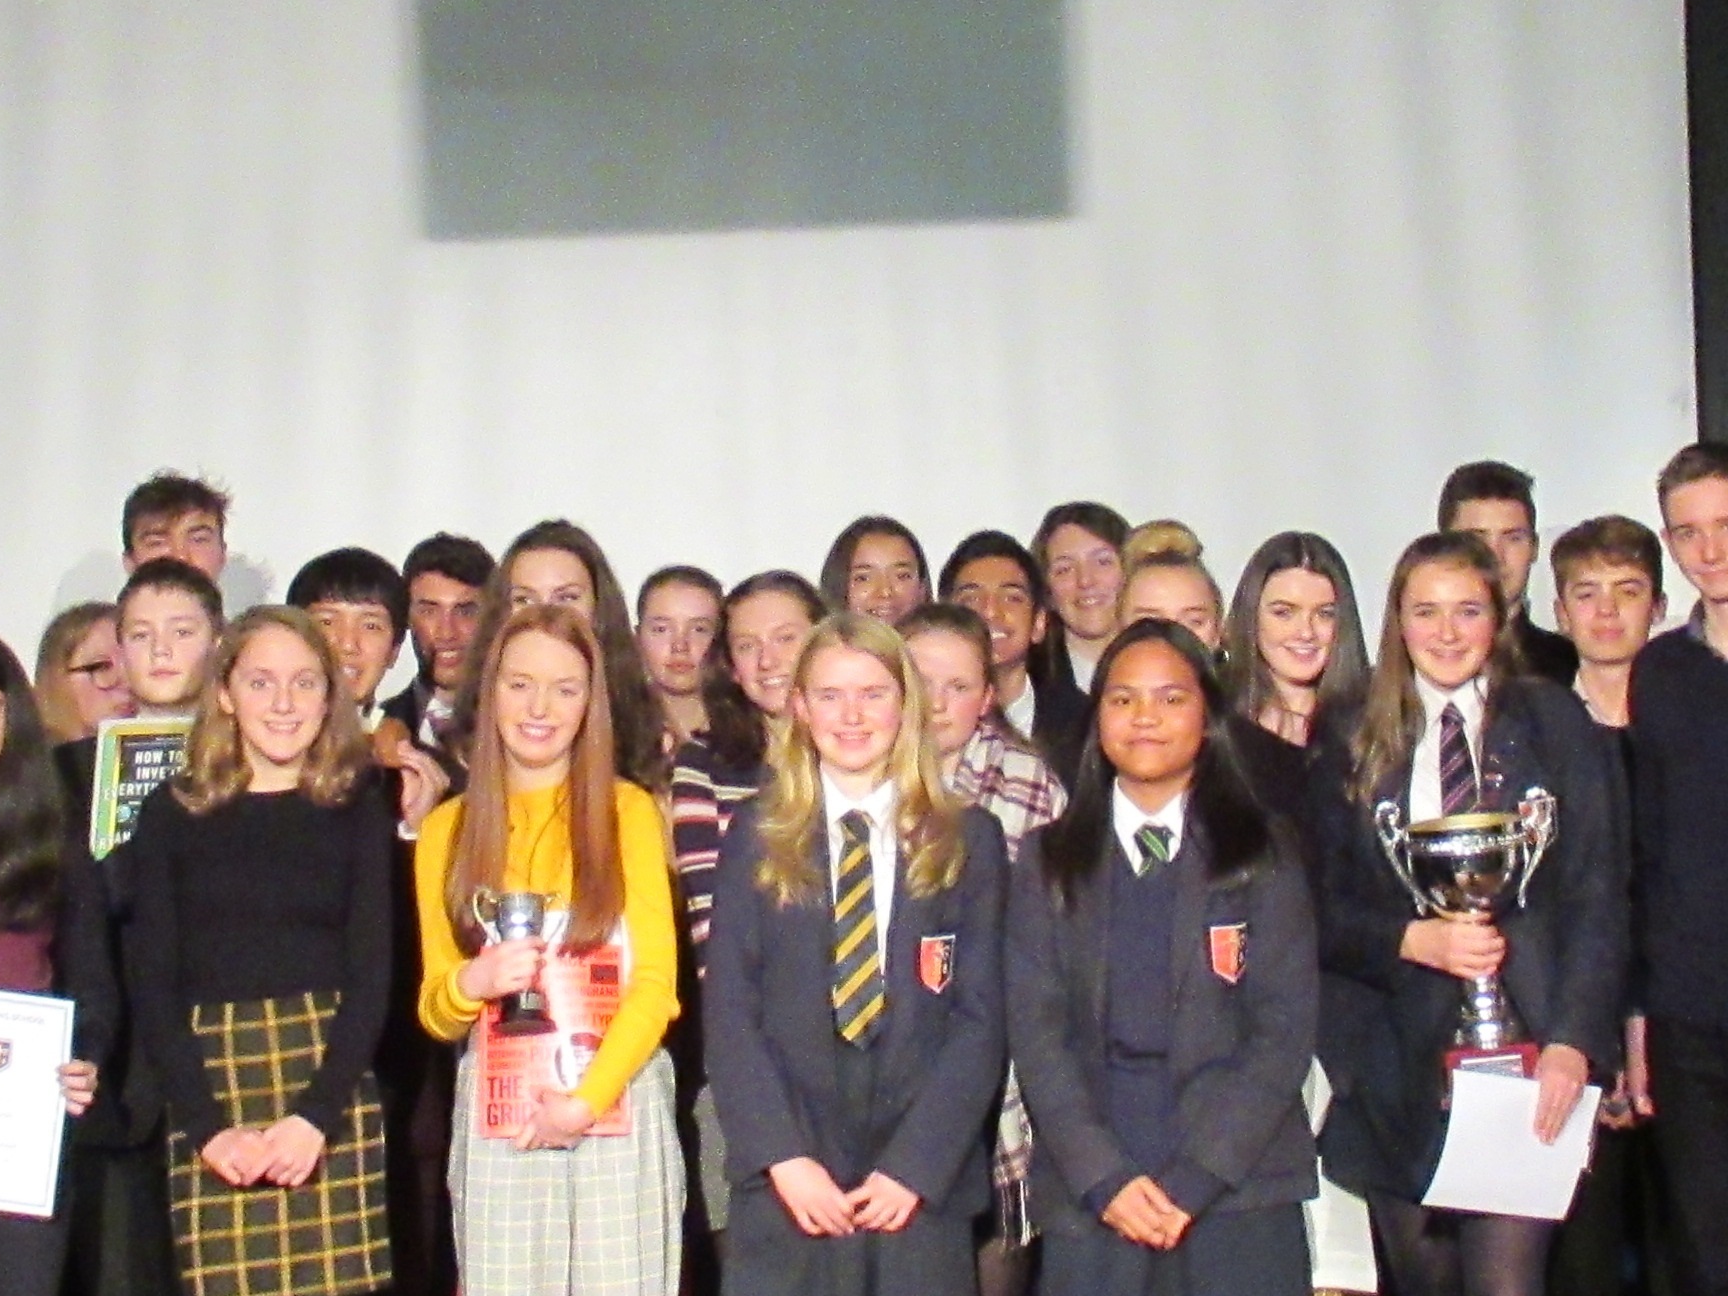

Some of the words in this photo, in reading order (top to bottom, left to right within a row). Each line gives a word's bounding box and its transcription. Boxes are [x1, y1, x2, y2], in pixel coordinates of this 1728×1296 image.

[135, 750, 164, 764] HOW
[168, 750, 183, 764] TO
[486, 1075, 524, 1100] THE
